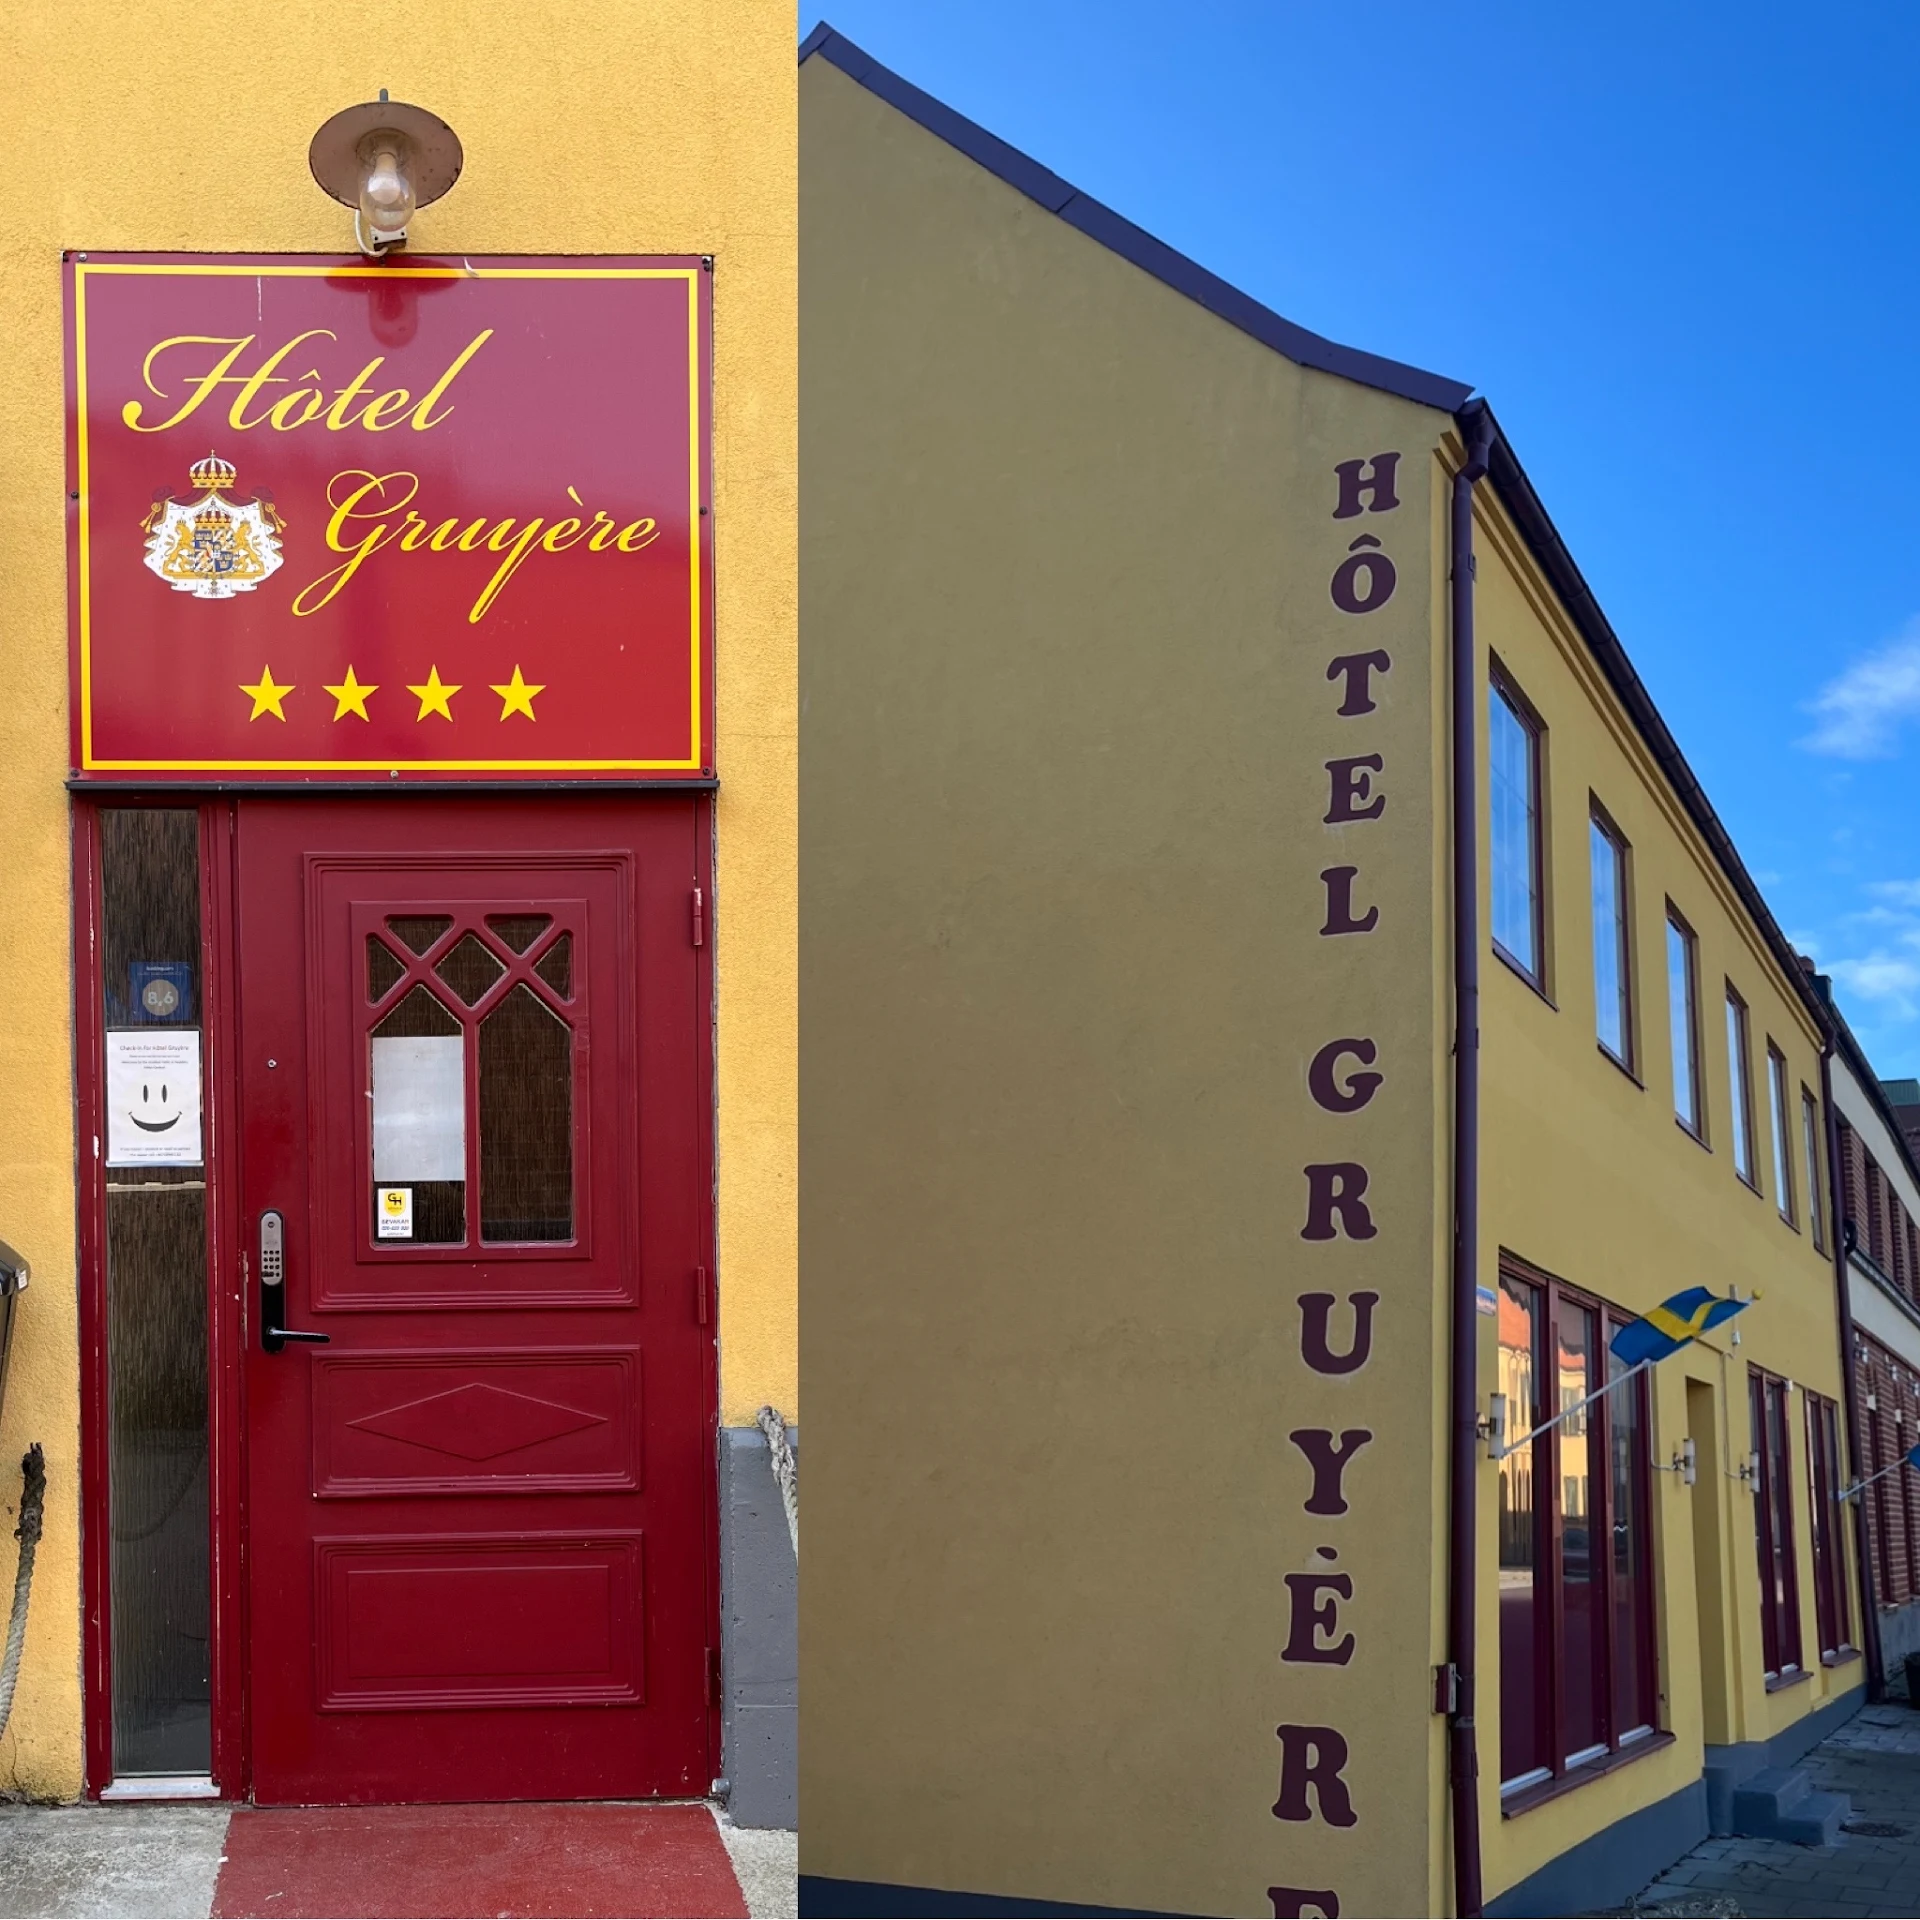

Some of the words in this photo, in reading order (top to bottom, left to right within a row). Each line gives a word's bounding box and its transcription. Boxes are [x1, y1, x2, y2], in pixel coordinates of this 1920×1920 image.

[121, 328, 495, 433] Hôtel
[291, 469, 661, 625] Gruyère
[1319, 451, 1402, 937] HÔTEL
